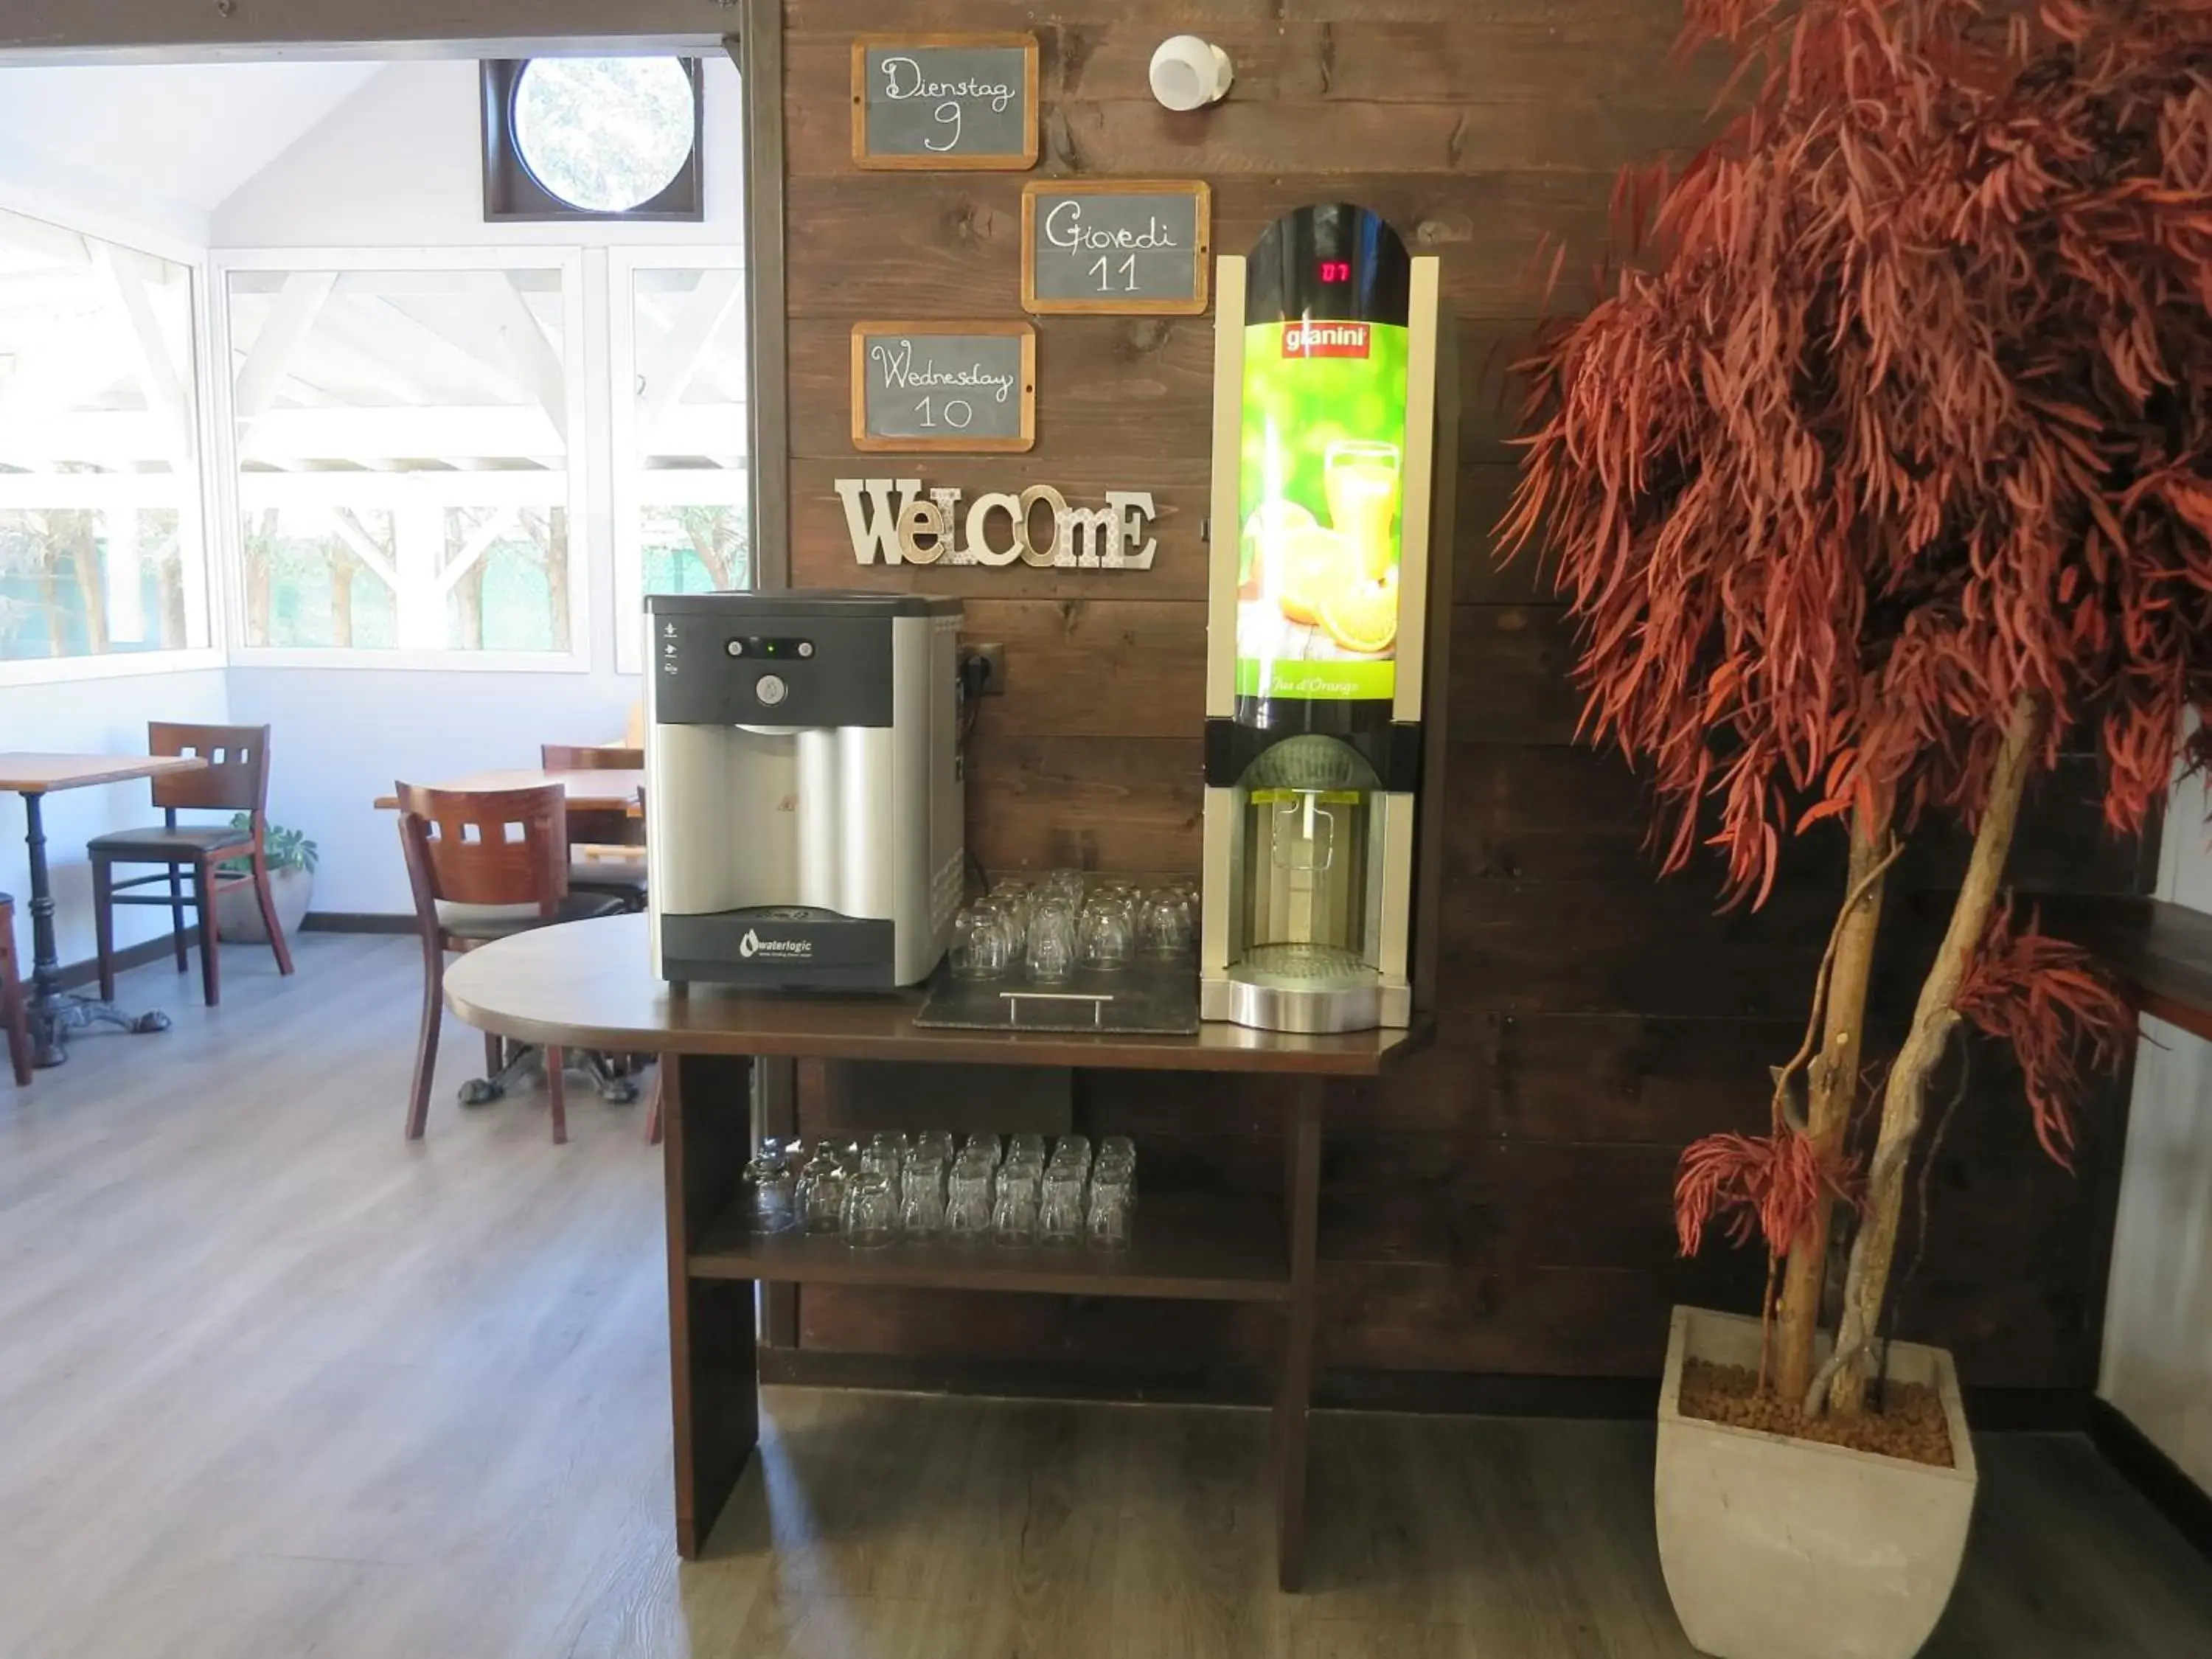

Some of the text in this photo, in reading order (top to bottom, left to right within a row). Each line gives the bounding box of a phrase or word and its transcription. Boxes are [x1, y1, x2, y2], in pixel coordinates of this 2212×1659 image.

[881, 57, 1015, 112] Dienstag
[924, 101, 961, 151] 9
[1046, 201, 1178, 254] Giovedi
[1088, 253, 1141, 291] 11
[871, 340, 1014, 403] Wednesday
[914, 396, 973, 428] 10
[758, 940, 812, 953] waterlogic
